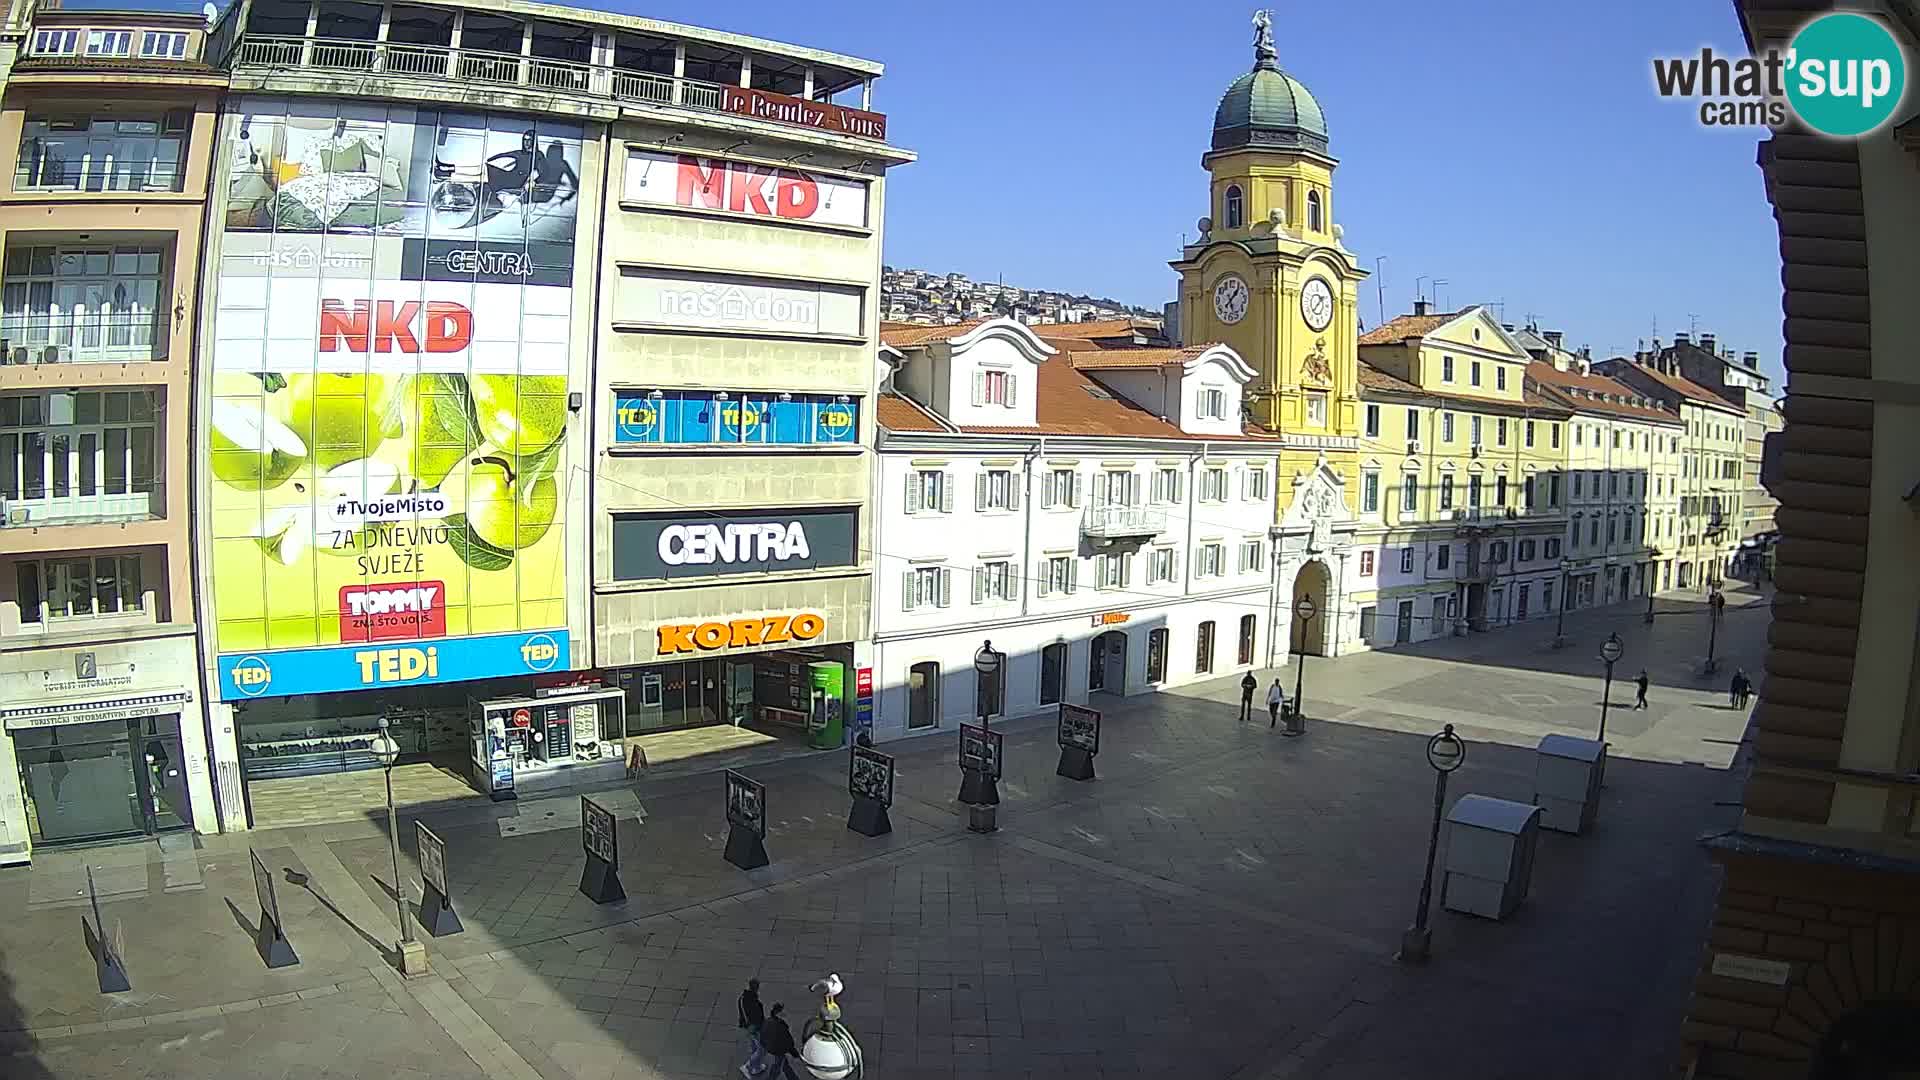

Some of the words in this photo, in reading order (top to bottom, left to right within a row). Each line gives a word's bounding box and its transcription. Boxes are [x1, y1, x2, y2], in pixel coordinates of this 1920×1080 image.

[722, 88, 744, 113] Le
[676, 154, 820, 219] NKD
[447, 250, 533, 276] CENTRA
[752, 291, 818, 324] dom
[319, 299, 475, 353] NKD
[336, 498, 444, 517] #TvojeMisto
[332, 529, 355, 549] ZA
[365, 526, 449, 548] DNEVNO
[658, 520, 809, 565] CENTRA
[358, 549, 424, 575] SVJEŽE
[346, 587, 438, 616] TOMMY
[378, 615, 398, 627] ŠTO
[657, 613, 825, 655] KORZO
[520, 643, 559, 661] TEDi
[232, 668, 272, 687] TEDi
[355, 647, 440, 684] TEDi
[77, 677, 132, 689] INFORMATION
[129, 706, 160, 717] CENTAR
